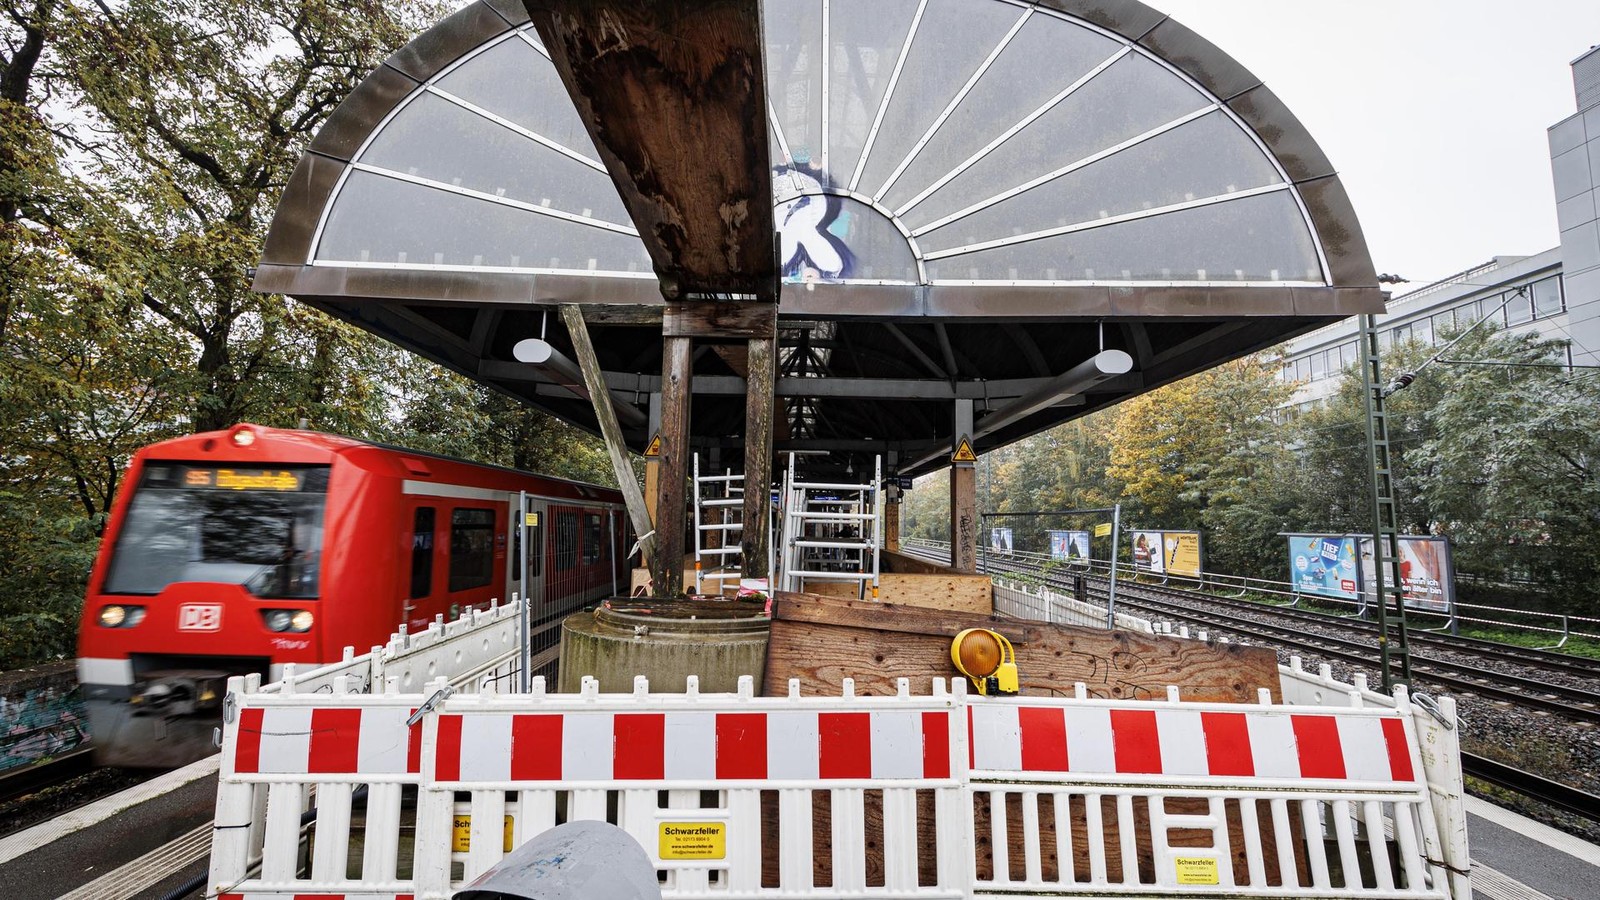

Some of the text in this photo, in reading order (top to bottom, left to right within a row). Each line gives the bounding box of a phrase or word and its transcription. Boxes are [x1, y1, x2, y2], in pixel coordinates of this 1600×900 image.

[1323, 541, 1339, 554] TIEF
[1406, 577, 1426, 585] wenn
[1427, 578, 1439, 586] ich
[1430, 586, 1442, 595] bin
[180, 605, 221, 630] DB
[665, 827, 719, 835] Schwarzfeller
